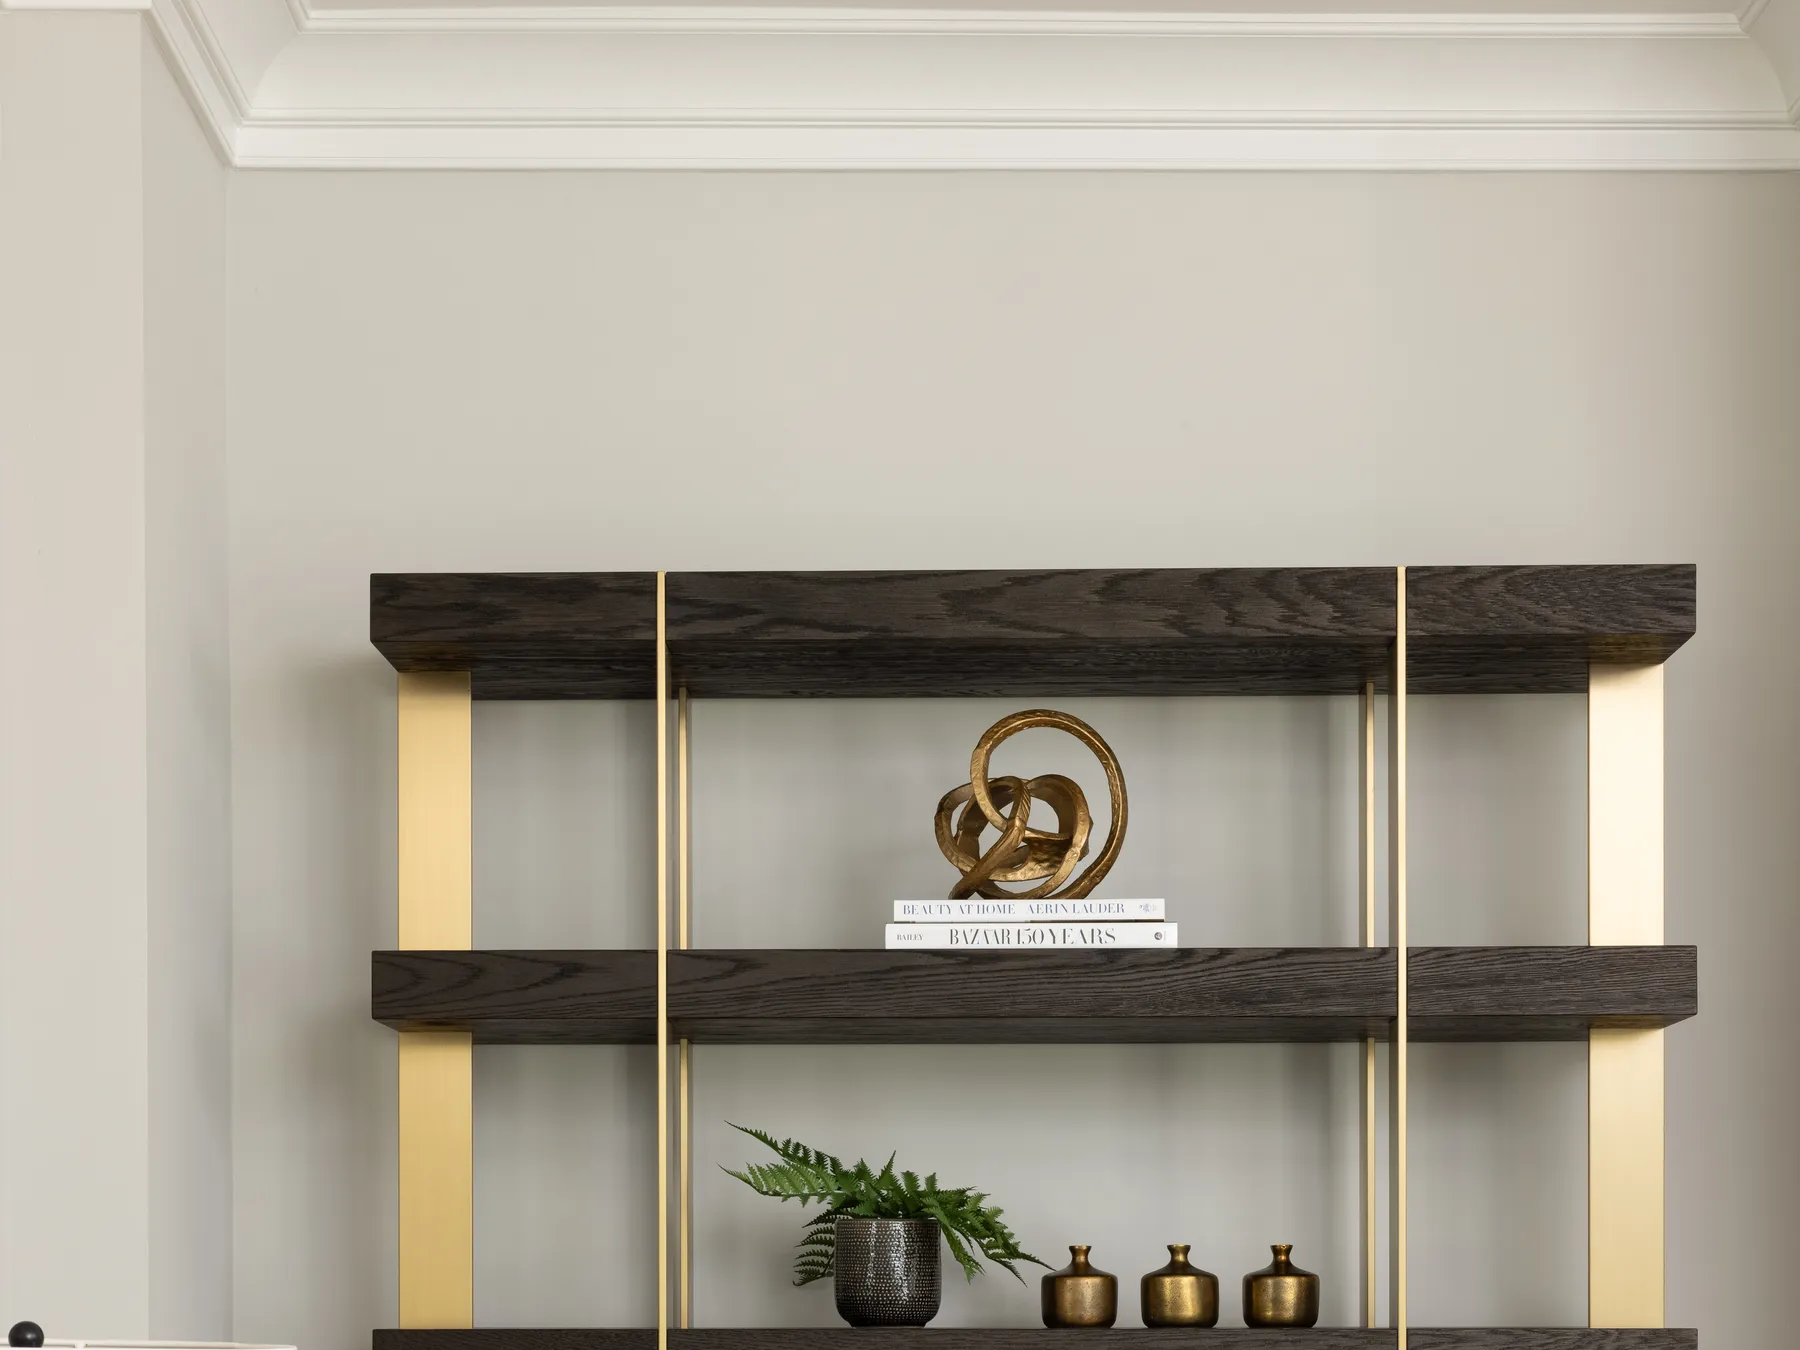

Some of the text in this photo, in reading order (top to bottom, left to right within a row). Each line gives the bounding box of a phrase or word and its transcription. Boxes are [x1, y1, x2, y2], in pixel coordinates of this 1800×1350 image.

[903, 904, 952, 915] BEAUTY
[976, 903, 1016, 915] HOME
[1026, 903, 1069, 914] AERIN
[1072, 903, 1125, 914] LAUDER
[949, 928, 1116, 946] BAZAAR 150 YEARS
